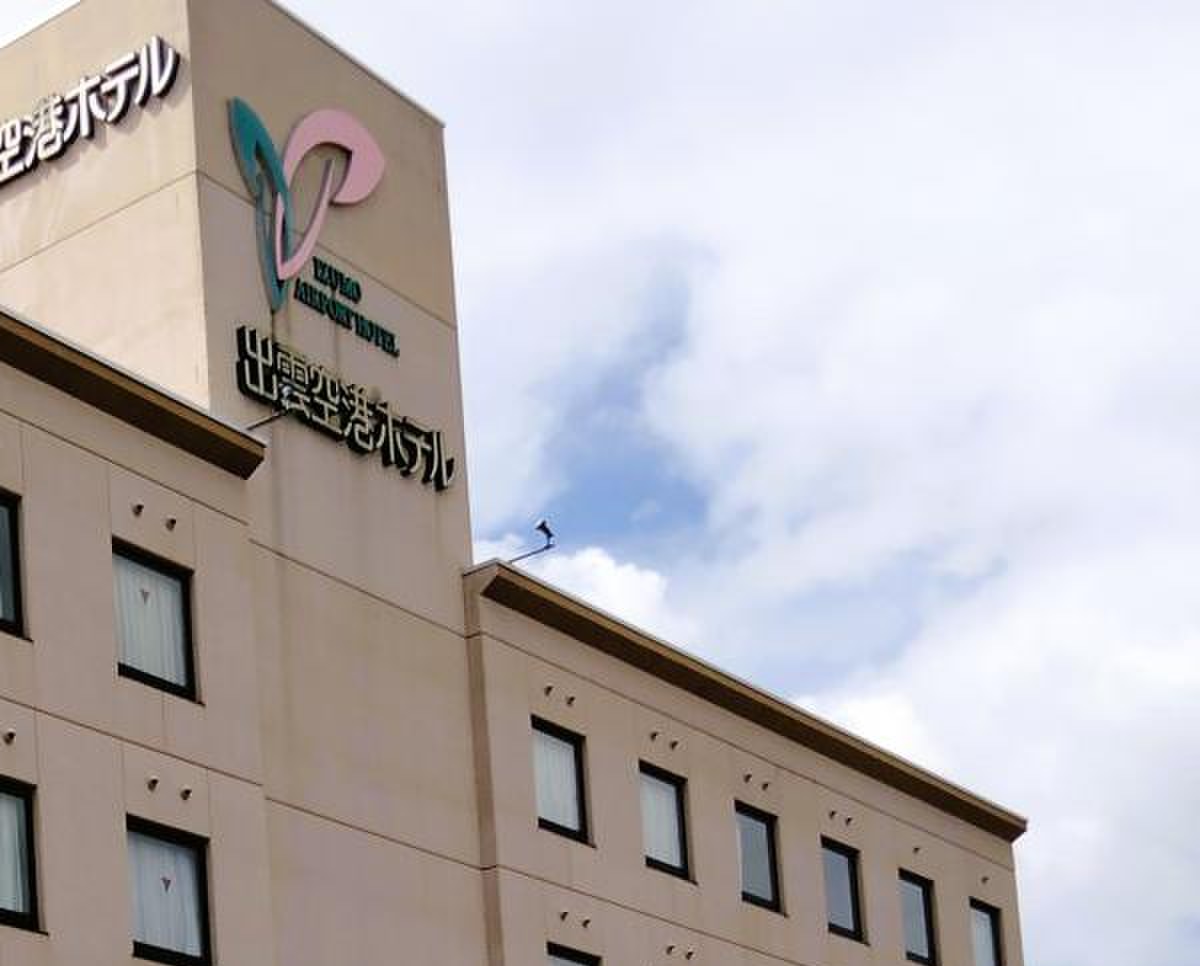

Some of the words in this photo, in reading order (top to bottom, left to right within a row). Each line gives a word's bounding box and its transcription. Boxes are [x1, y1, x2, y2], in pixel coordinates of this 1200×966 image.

[294, 278, 352, 330] AIRPORT
[354, 311, 400, 357] HOTEL
[313, 256, 362, 304] IZUMO
[236, 325, 454, 492] 出雲空港ホテル
